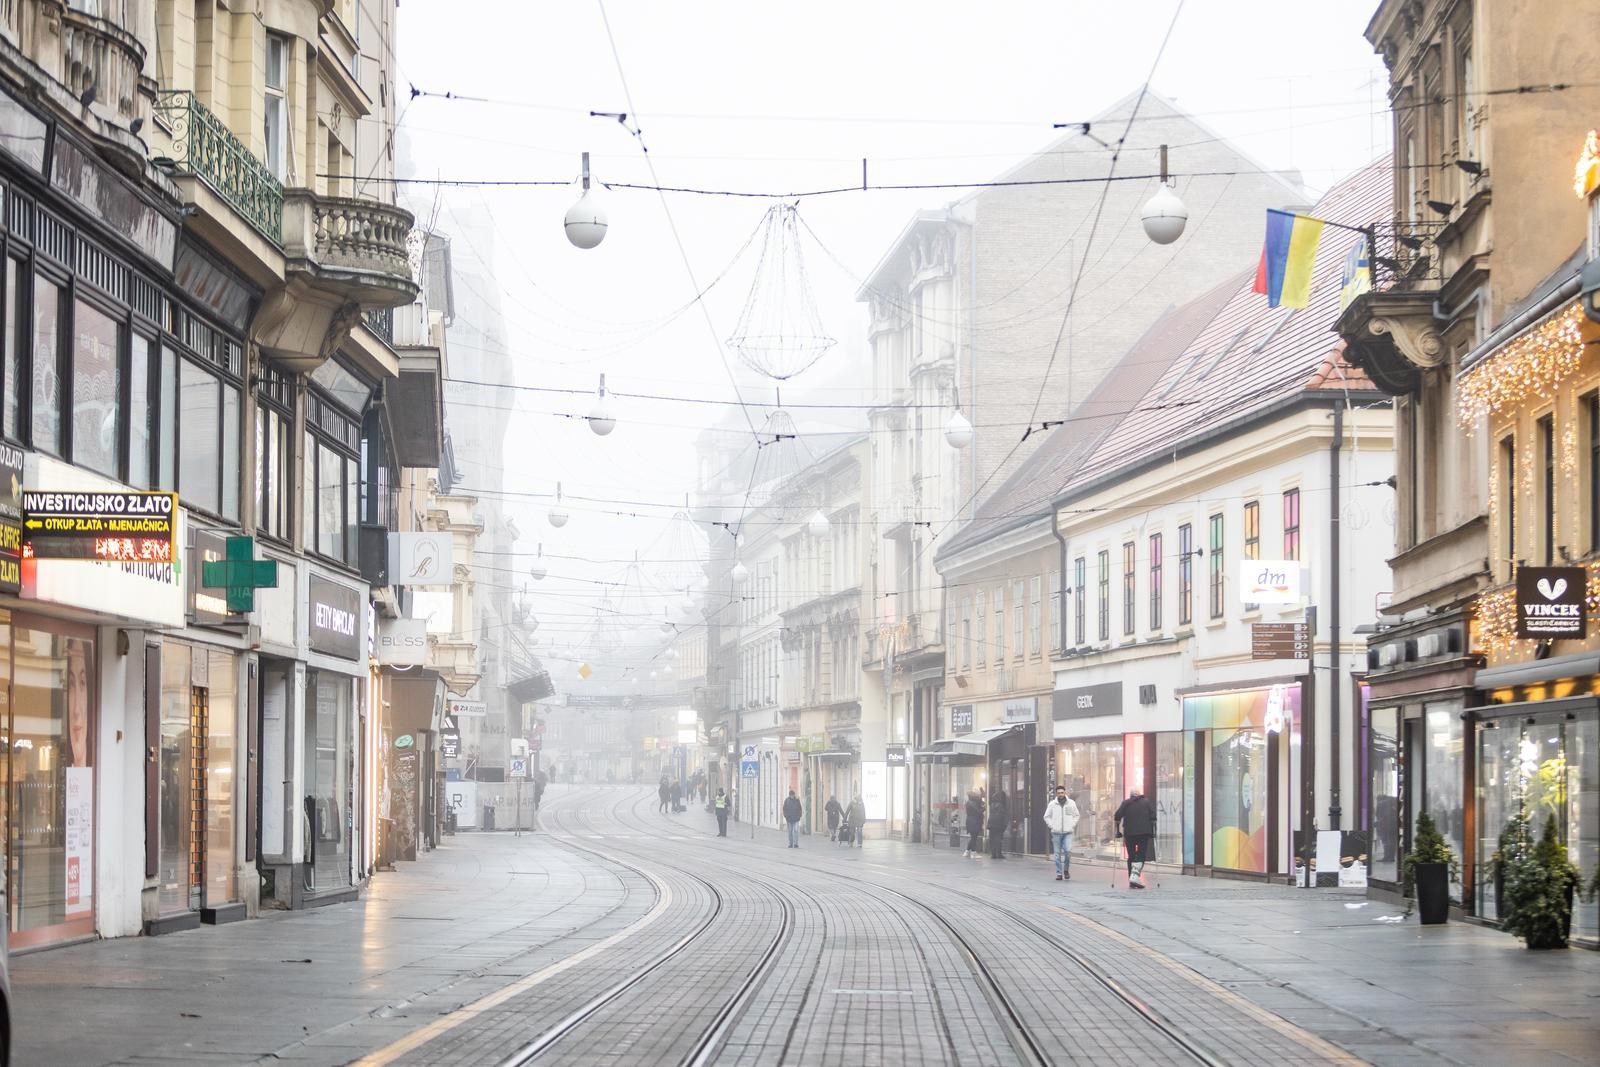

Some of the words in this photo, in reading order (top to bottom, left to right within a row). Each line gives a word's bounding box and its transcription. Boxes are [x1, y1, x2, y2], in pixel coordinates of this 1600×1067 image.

[5, 446, 23, 471] ZLATO
[24, 493, 125, 512] INVESTICIJSKO
[127, 495, 172, 514] ZLATO
[45, 519, 75, 531] OTKUP
[76, 520, 103, 531] ZLATA
[109, 518, 170, 532] MJENJAČNICA
[1, 559, 20, 585] ZLATA
[1257, 568, 1286, 585] dm
[1524, 604, 1580, 616] VINCEK
[382, 636, 424, 647] BLSS
